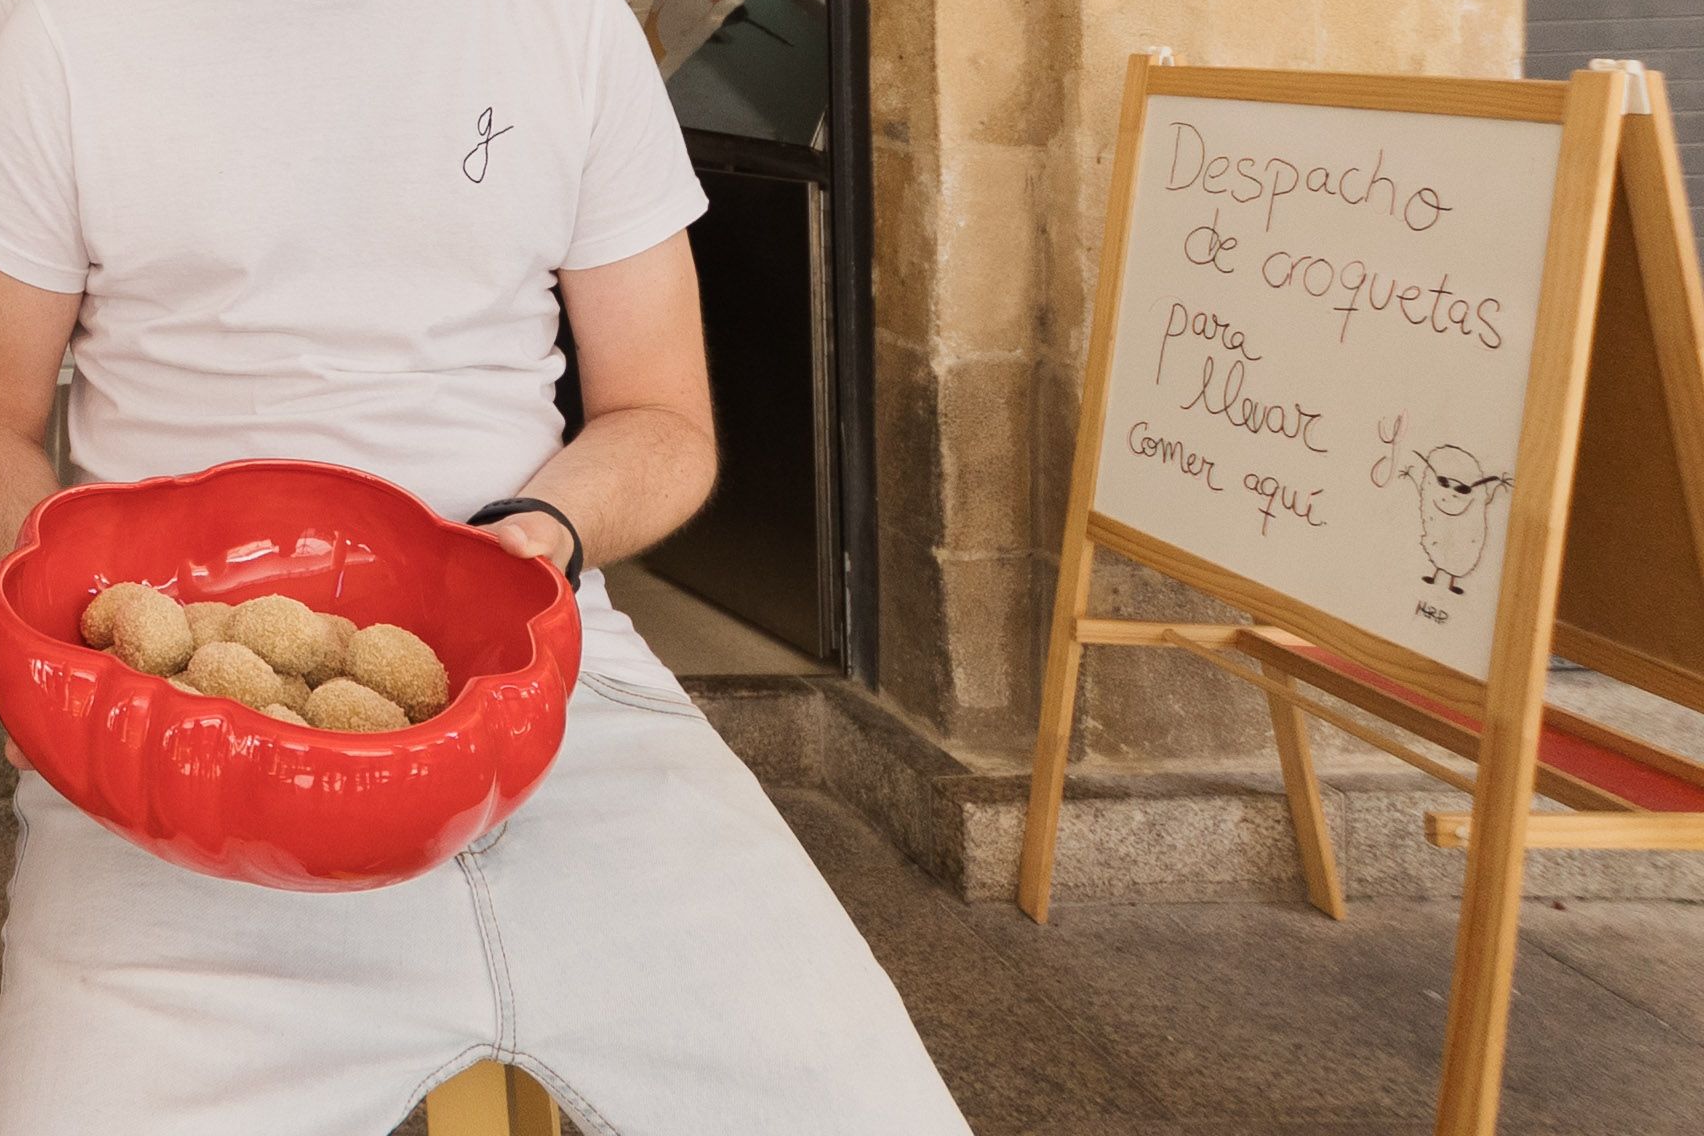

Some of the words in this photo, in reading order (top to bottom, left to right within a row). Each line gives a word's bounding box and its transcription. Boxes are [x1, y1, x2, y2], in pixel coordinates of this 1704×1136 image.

[462, 106, 515, 184] g
[1164, 120, 1453, 233] Despacho
[1183, 208, 1238, 274] de
[1260, 250, 1502, 350] croquetas
[1155, 301, 1263, 385] para
[1179, 354, 1328, 455] llevar
[1370, 407, 1406, 489] y
